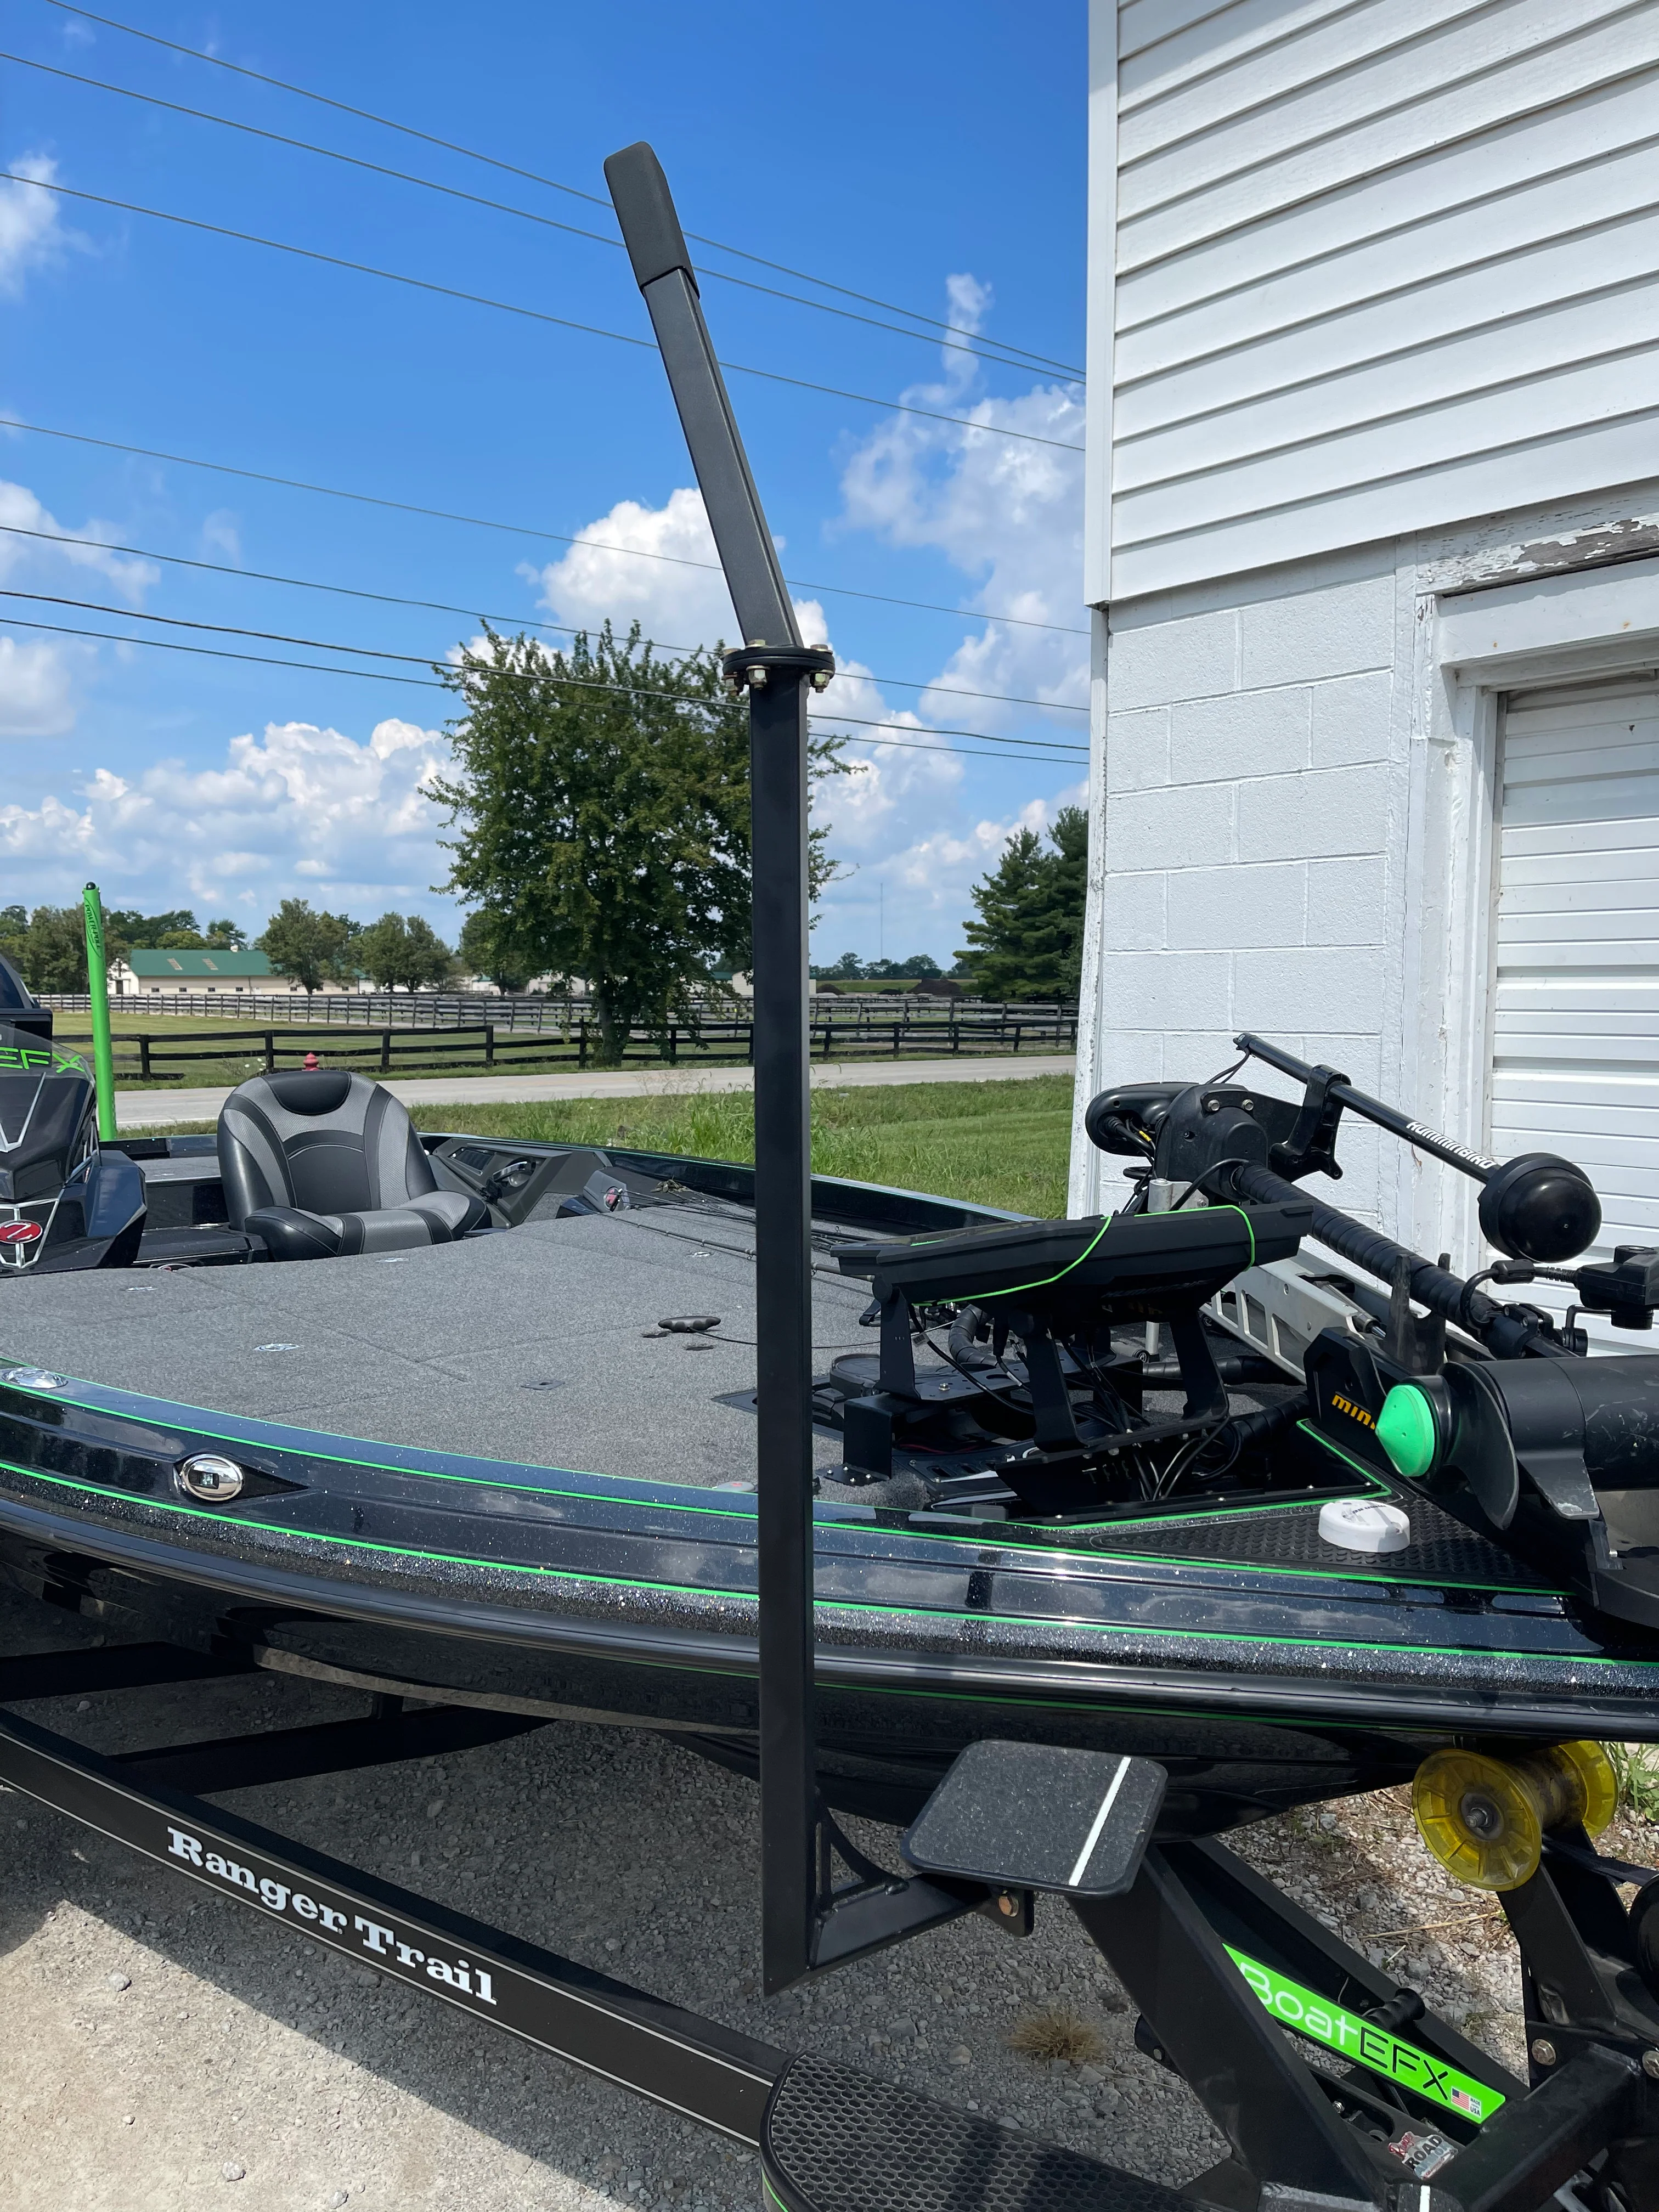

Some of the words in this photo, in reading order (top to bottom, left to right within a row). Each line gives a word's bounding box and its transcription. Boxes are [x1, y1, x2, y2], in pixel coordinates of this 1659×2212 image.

[1406, 1121, 1497, 1169] HUMMINBIRD
[167, 1826, 348, 1933] Ranger
[354, 1915, 496, 2005] Trail
[1470, 2097, 1480, 2106] MADE
[1470, 2106, 1480, 2116] USA
[1404, 2135, 1442, 2170] ROAD
